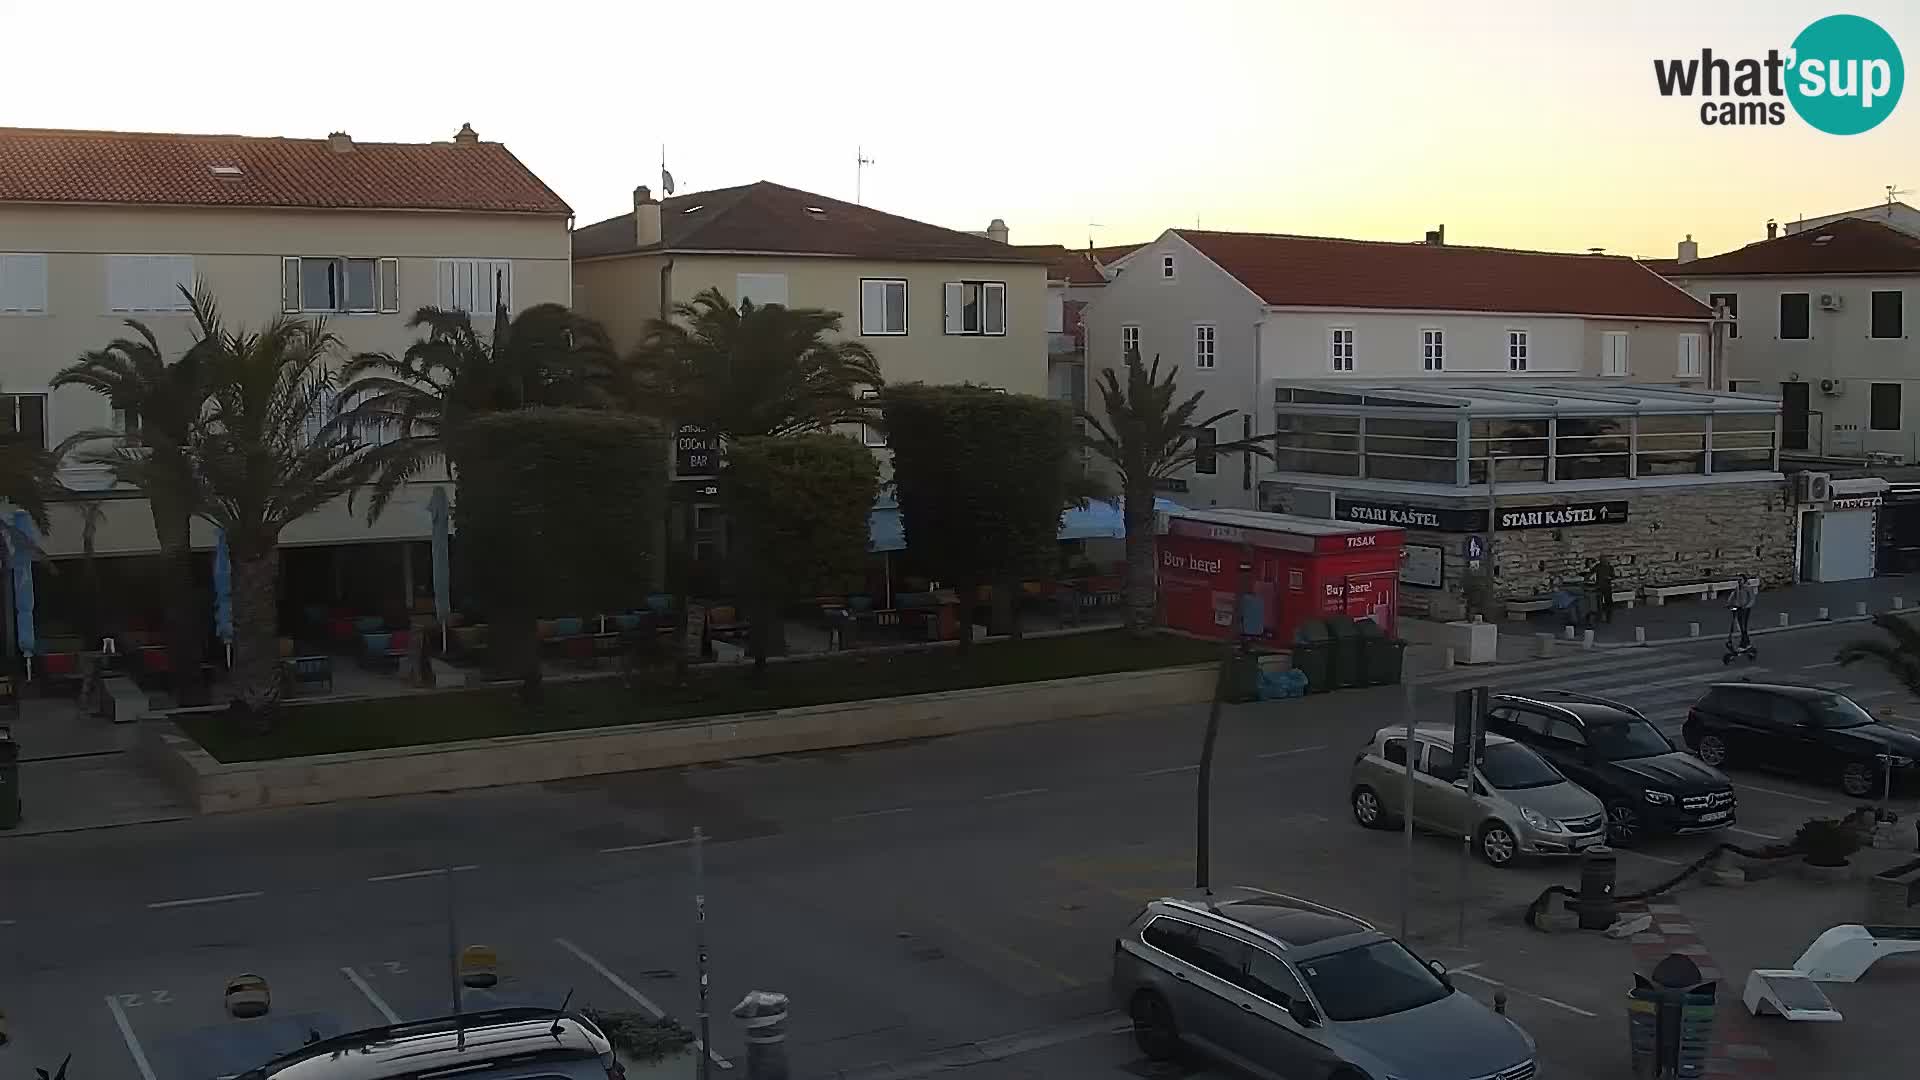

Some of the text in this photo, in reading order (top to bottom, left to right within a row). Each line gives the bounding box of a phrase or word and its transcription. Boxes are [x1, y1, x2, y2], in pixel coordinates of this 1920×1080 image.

[690, 455, 708, 467] BAR
[1351, 507, 1440, 527] STARI KAŠTEL
[1502, 506, 1596, 527] STARI KAŠTEL
[1347, 536, 1376, 547] TISAK
[1190, 553, 1222, 573] here!
[1326, 584, 1345, 596] Buy
